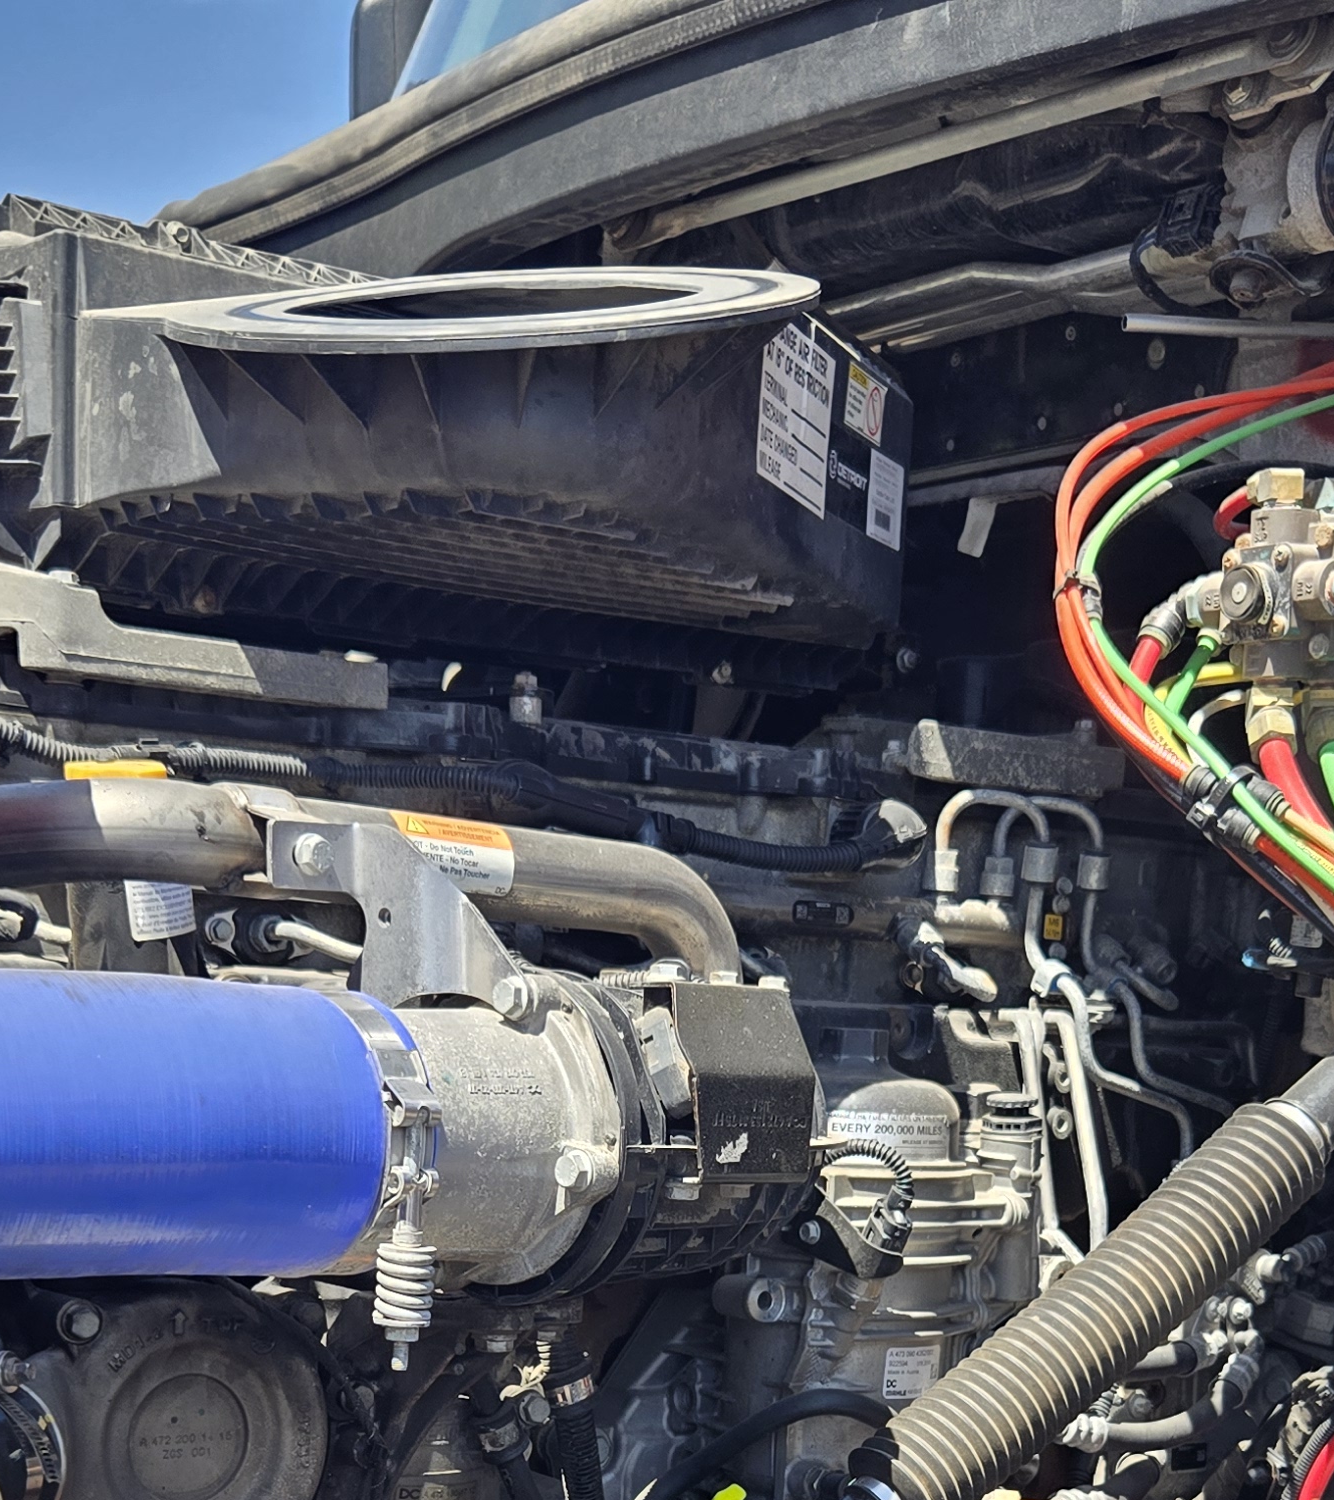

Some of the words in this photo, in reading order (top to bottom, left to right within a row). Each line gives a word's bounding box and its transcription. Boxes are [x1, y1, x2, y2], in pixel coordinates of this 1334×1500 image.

[799, 339, 809, 363] AIR
[811, 348, 828, 378] FILTER
[765, 371, 787, 406] TERMINAL
[767, 341, 774, 361] AT
[785, 355, 793, 377] OF
[794, 362, 829, 408] RESTRICTION
[763, 397, 788, 432] MECHANIC
[760, 423, 773, 449] DATE
[775, 434, 798, 466] CHANGED
[759, 451, 781, 481] MILEAGE
[837, 462, 867, 491] DETROIT
[429, 842, 440, 850] Do
[441, 845, 453, 853] Not
[454, 846, 474, 856] Touch
[450, 857, 460, 866] No
[461, 859, 479, 868] Tocar
[439, 865, 449, 874] Ne
[450, 867, 462, 876] Pas
[463, 869, 490, 880] Toucher
[832, 1123, 871, 1133] EVERY
[874, 1125, 915, 1136] 200,000
[917, 1126, 943, 1135] MILES
[887, 1379, 897, 1388] DC
[399, 1488, 420, 1499] DC
